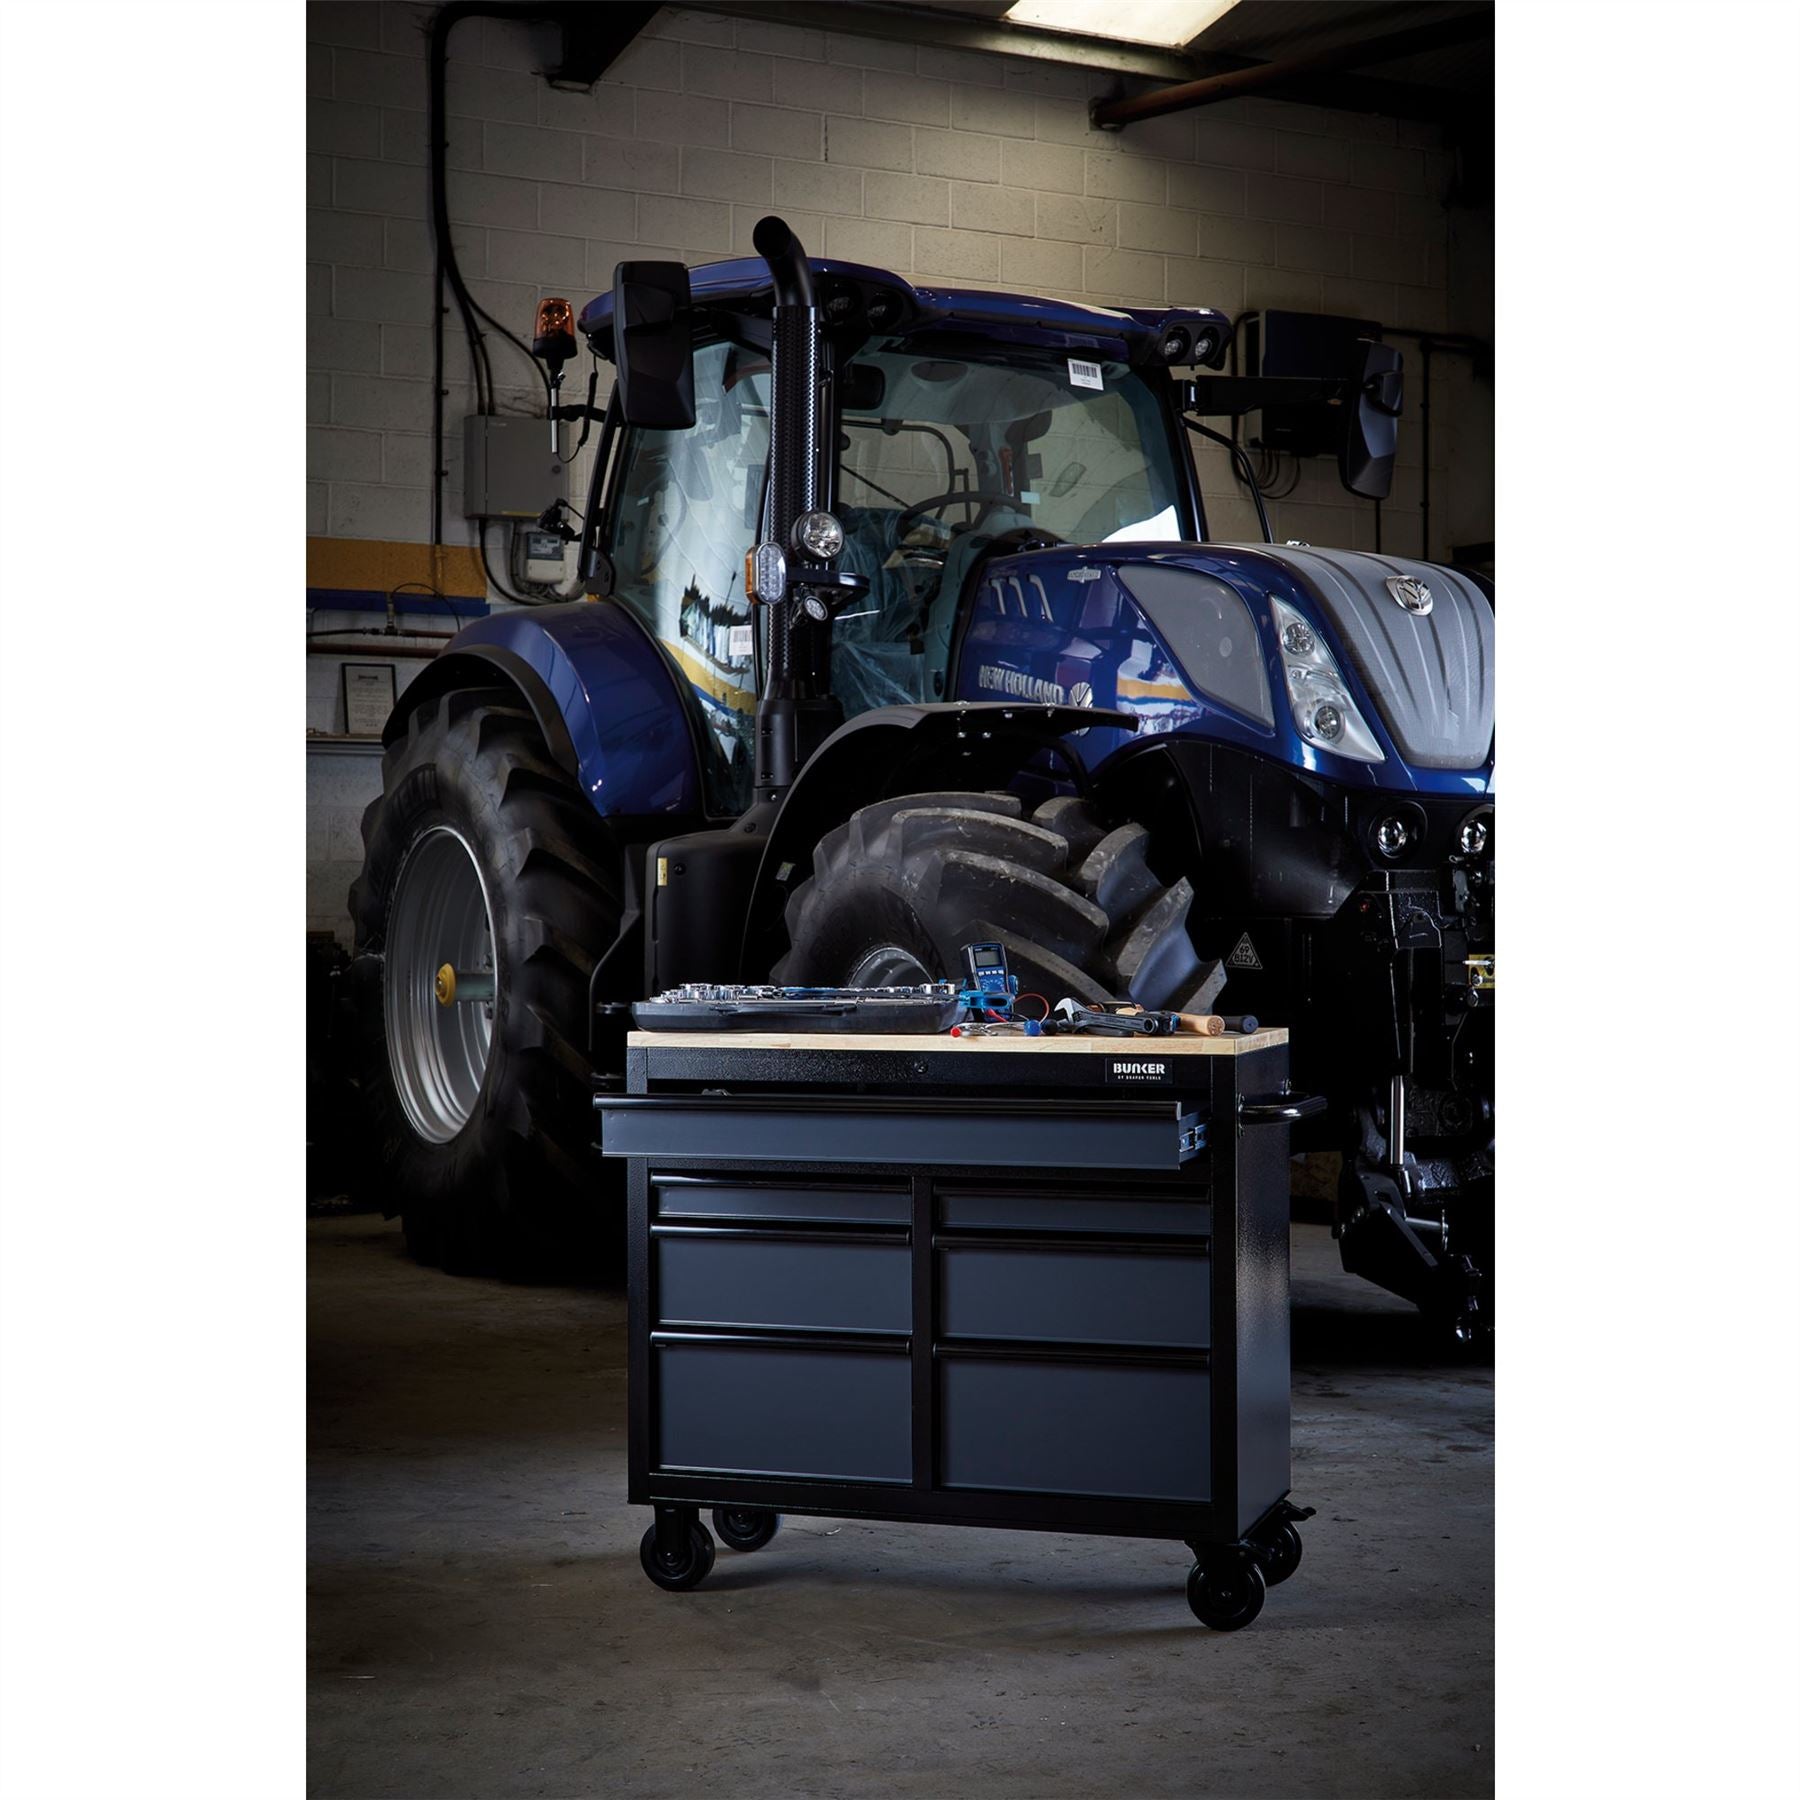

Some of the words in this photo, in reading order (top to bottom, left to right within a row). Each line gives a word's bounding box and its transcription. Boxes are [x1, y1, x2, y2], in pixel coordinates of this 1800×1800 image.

[979, 664, 1005, 692] NEW
[1005, 670, 1065, 705] HOLLAND
[1113, 1063, 1165, 1074] BUNKER
